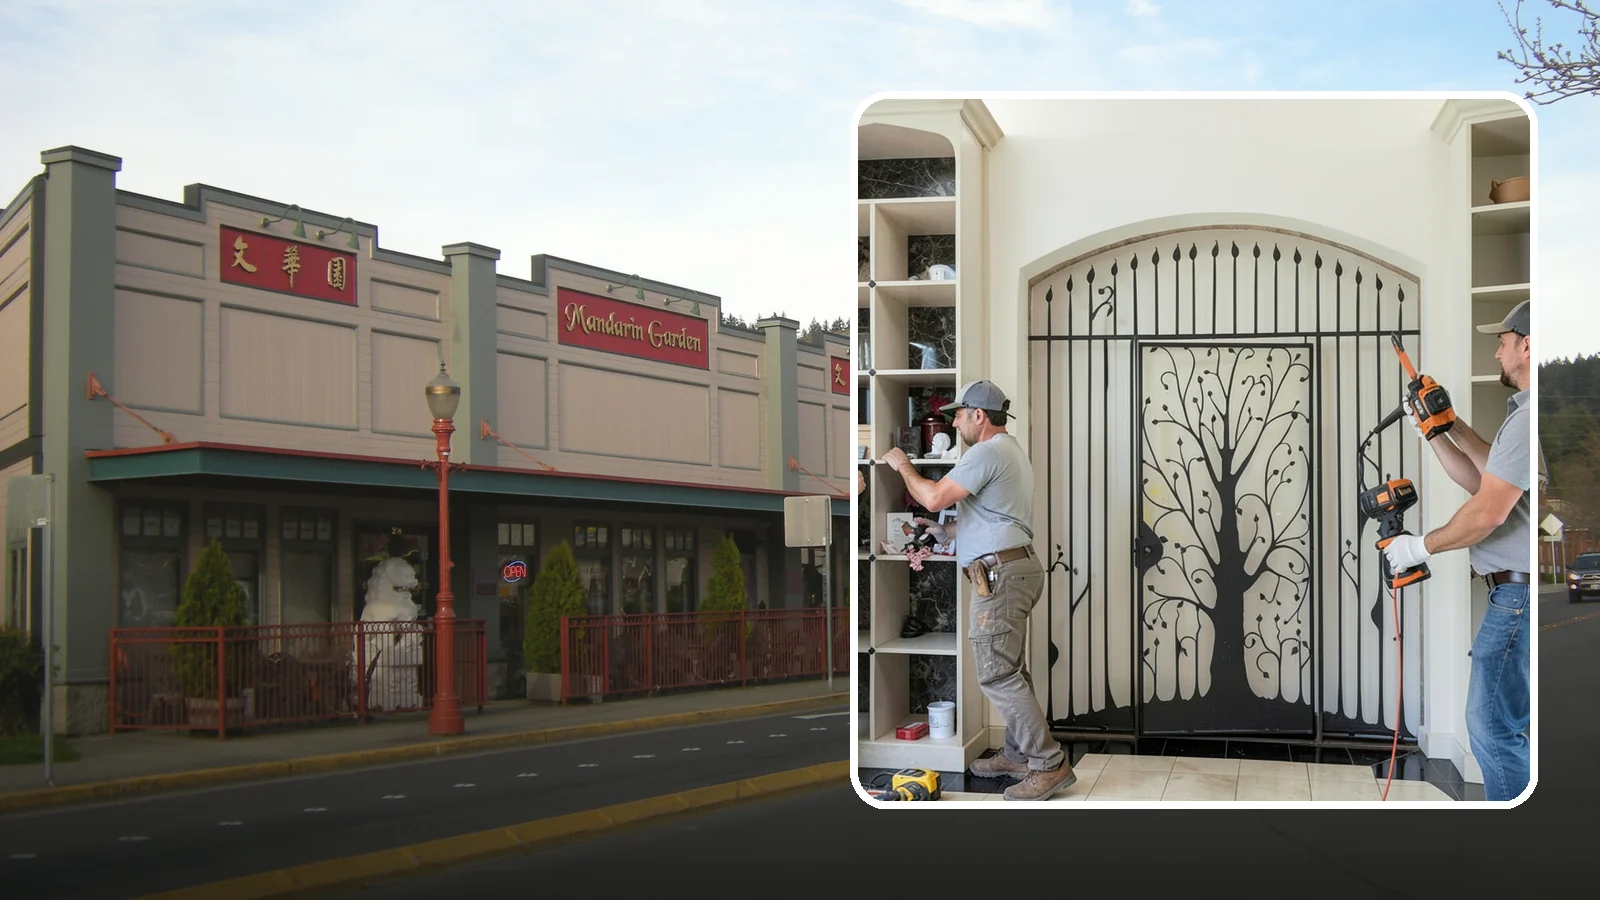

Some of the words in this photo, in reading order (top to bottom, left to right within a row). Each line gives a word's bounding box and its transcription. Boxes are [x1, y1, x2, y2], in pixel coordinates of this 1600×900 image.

[231, 236, 346, 291] 文華園
[564, 302, 644, 340] Mandarin
[648, 320, 701, 352] Garden
[503, 565, 527, 578] OPEN
